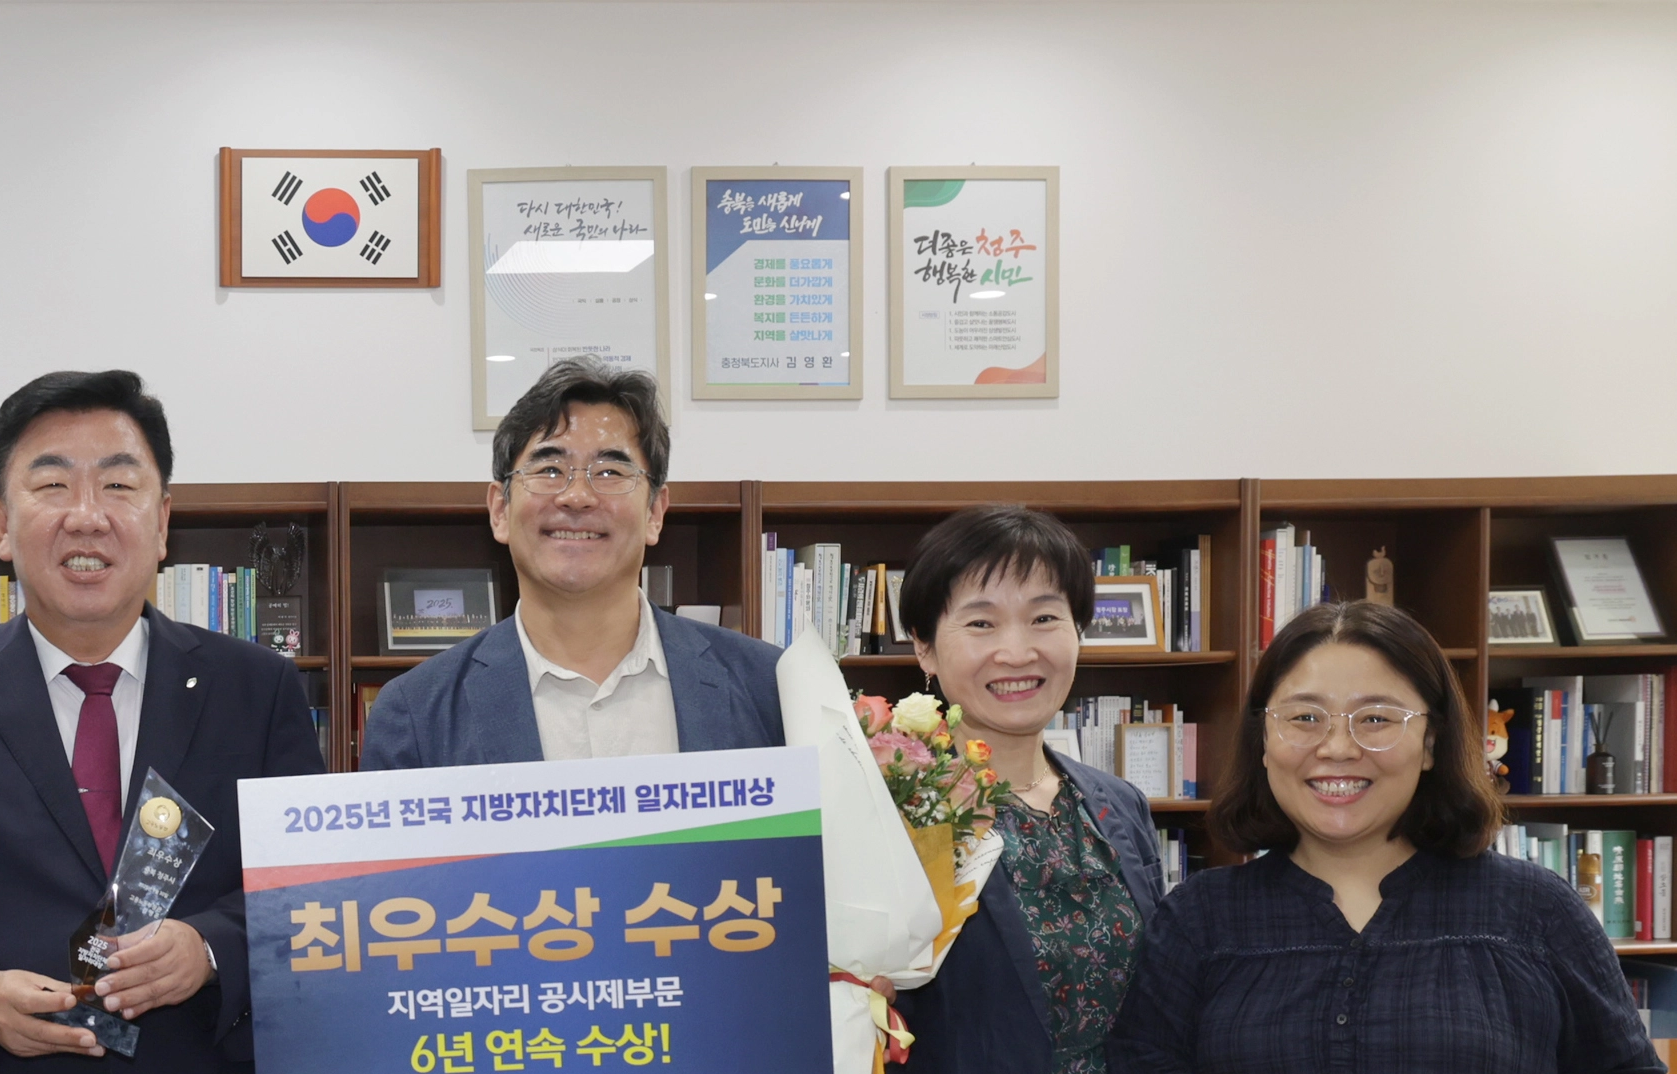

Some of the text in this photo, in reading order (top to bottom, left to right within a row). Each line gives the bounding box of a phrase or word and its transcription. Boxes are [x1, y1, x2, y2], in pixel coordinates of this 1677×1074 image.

[517, 197, 623, 219] 다시 대한민국!
[717, 189, 803, 215] 충북을 새롭게
[524, 219, 648, 241] 새로운 국민의 나라
[740, 213, 823, 237] 도민을 신나게
[975, 227, 1037, 259] 청주
[754, 258, 833, 270] 경제를 풍요롭게
[754, 276, 833, 288] 문화를 더가깝게
[914, 258, 1033, 304] 행복한 시민
[789, 294, 833, 306] 가치있게
[754, 312, 833, 324] 복지를 든든하게
[754, 330, 833, 342] 지역을 살맛나게
[721, 357, 780, 369] 충청북도지사
[284, 777, 775, 834] 2025년 전국 지방자치단체 일자리대상
[147, 847, 183, 868] 최우수상
[290, 876, 782, 973] 최우수상 수상
[87, 935, 109, 950] 2025
[387, 976, 683, 1020] 지역일자리 공시제부문
[410, 1023, 671, 1074] 6년 연속 수상!
